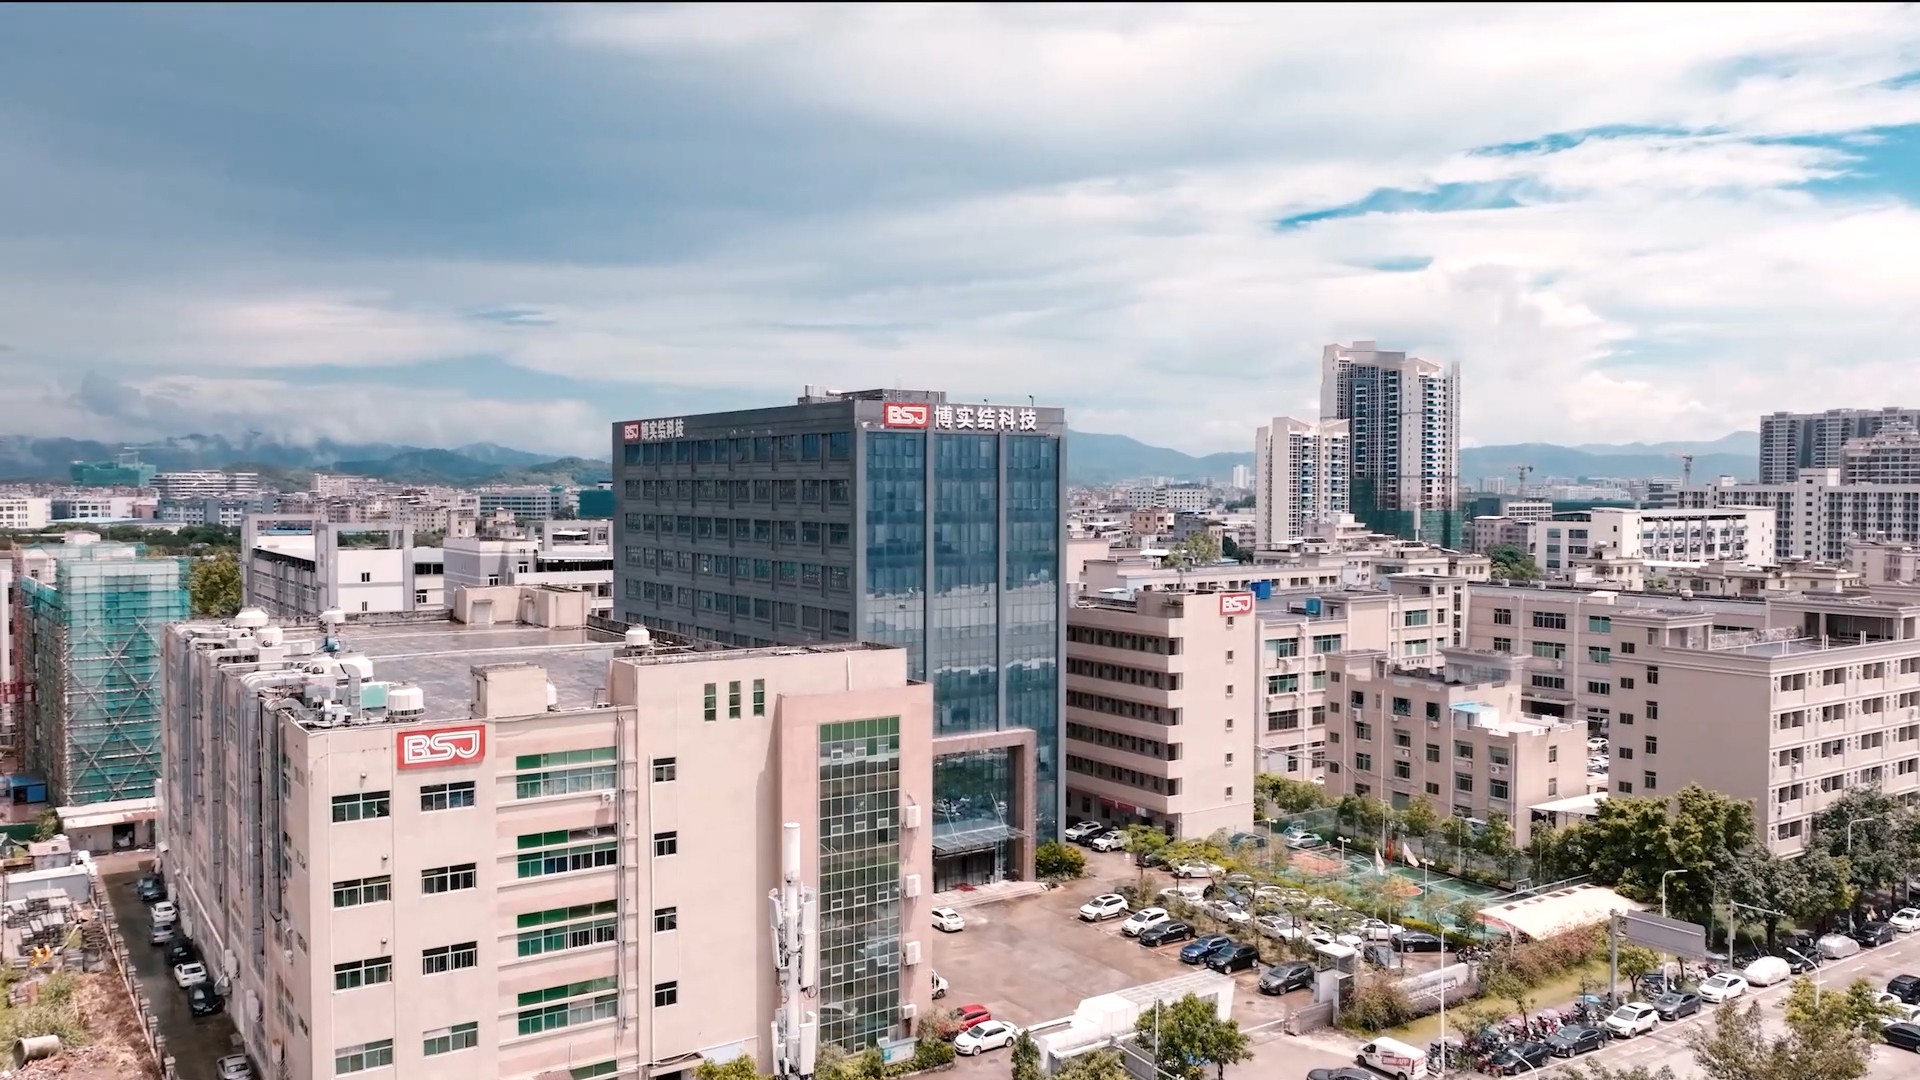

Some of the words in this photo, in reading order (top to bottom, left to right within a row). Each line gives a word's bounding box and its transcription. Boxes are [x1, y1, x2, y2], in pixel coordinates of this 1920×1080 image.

[887, 405, 927, 424] BSJ
[934, 405, 1037, 431] 博实结科技
[1222, 595, 1251, 612] BSJ
[404, 729, 480, 765] BSJ
